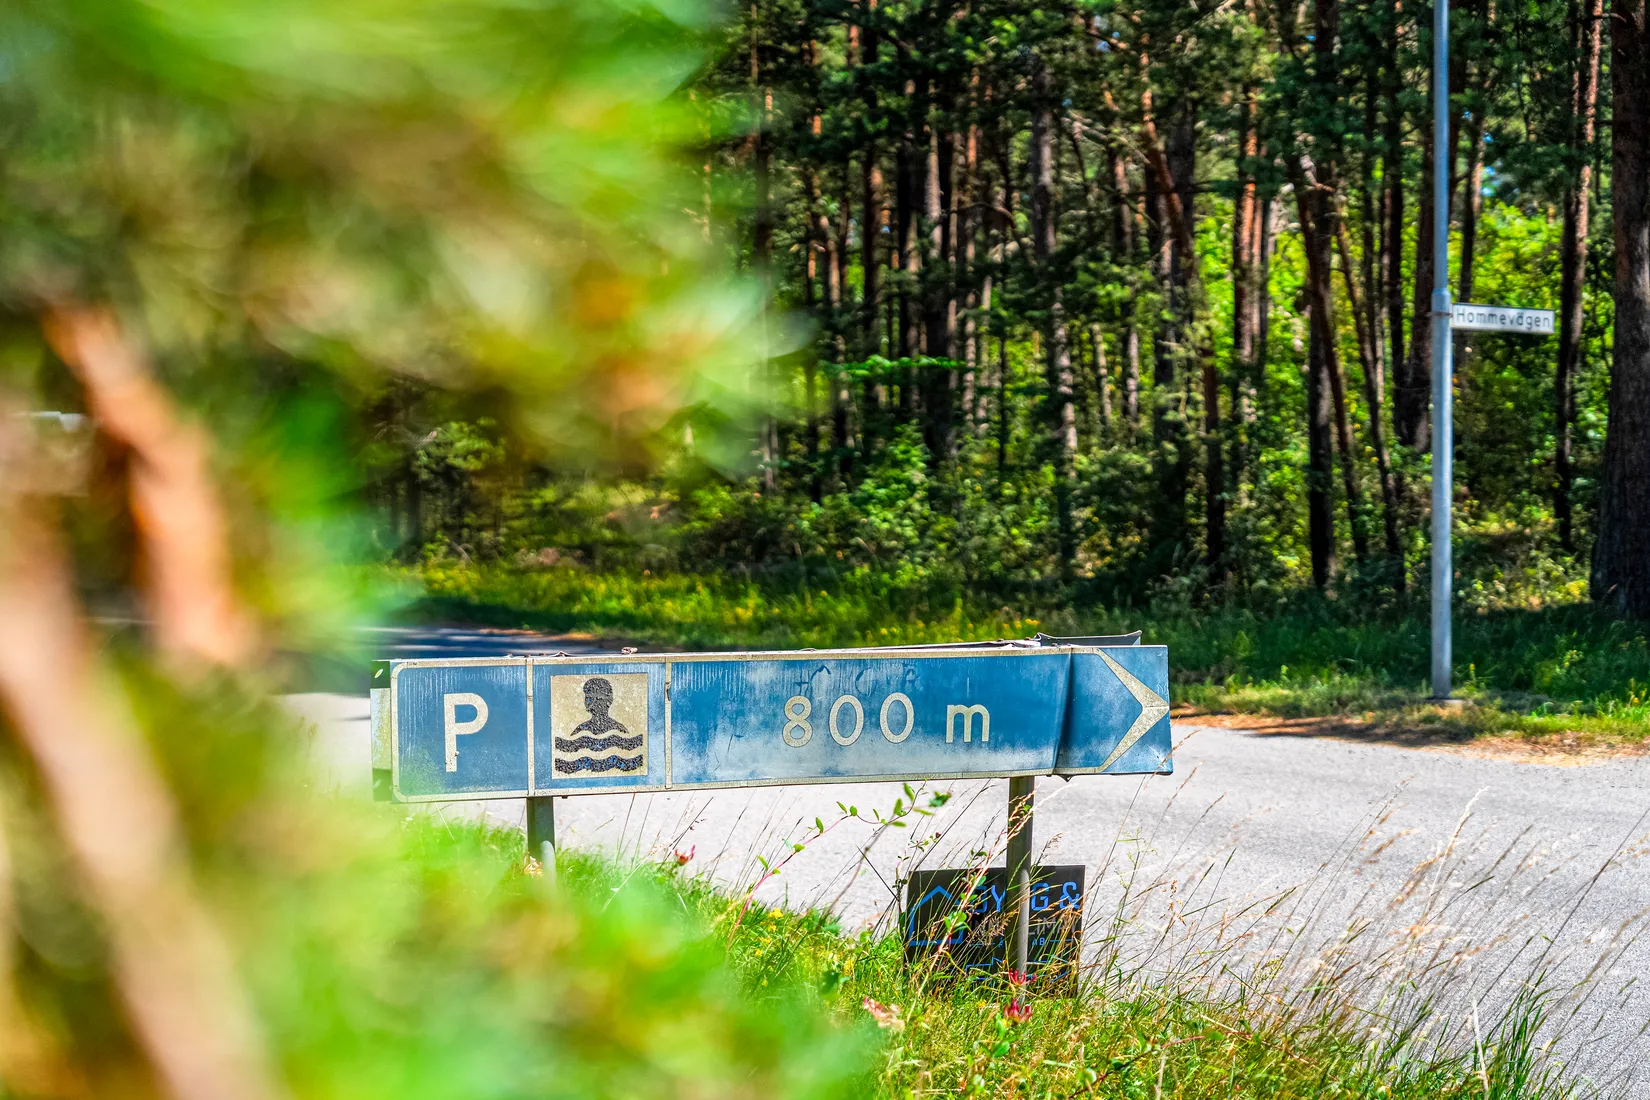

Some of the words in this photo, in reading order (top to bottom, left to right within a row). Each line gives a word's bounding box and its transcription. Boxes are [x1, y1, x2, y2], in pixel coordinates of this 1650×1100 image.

[1456, 307, 1550, 329] Hommevägen
[443, 692, 489, 773] P
[782, 692, 915, 748] 800
[945, 704, 991, 744] m
